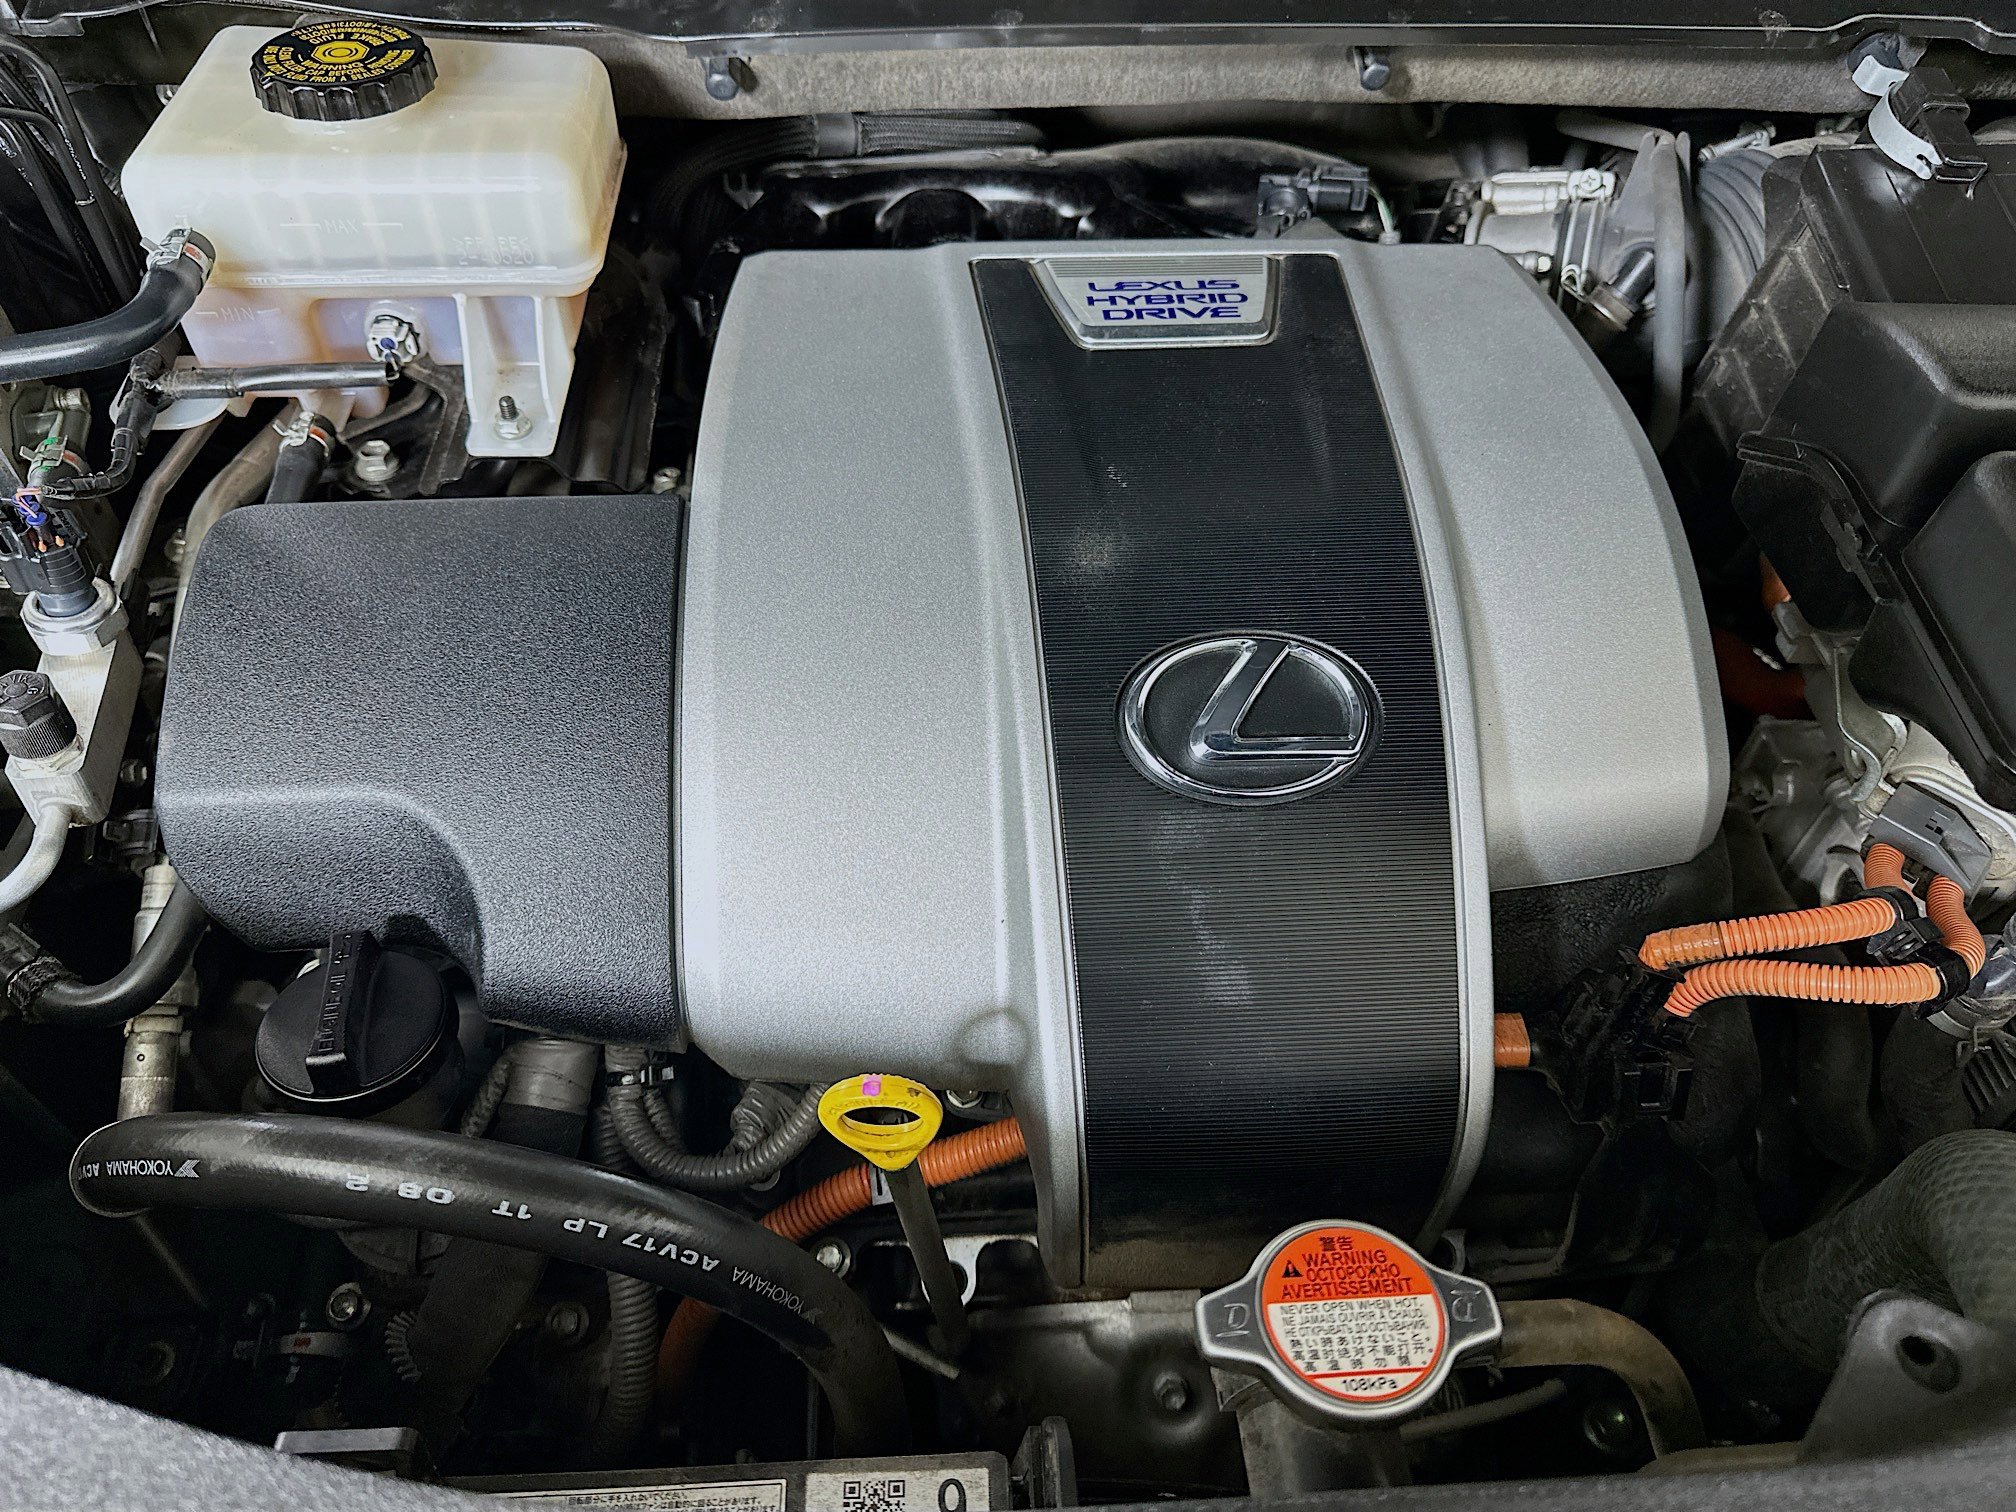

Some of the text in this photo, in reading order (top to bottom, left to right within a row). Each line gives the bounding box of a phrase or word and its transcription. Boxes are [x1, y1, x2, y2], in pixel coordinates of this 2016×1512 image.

[309, 33, 344, 44] FLUID
[350, 33, 385, 46] BRAKE
[301, 60, 364, 71] WARNING
[329, 66, 367, 76] BEFORE
[283, 71, 308, 81] FLUID
[351, 69, 385, 81] SEALED
[324, 220, 358, 234] MAX
[1088, 280, 1240, 292] LEXUS
[1086, 293, 1248, 307] HYBRID
[220, 306, 255, 322] MIN
[1102, 307, 1241, 321] DRIVE
[106, 1160, 173, 1177] YOKOHAMA
[346, 1173, 370, 1192] 2
[397, 1181, 456, 1205] 08
[491, 1200, 533, 1220] 1T
[563, 1218, 609, 1239] LP
[621, 1232, 721, 1272] ACV17
[1319, 1236, 1353, 1252] 警告
[1302, 1249, 1387, 1268] WARNING
[1306, 1263, 1400, 1283] ОСТОРОЖНО
[731, 1267, 805, 1314] YOKOHAMA
[1281, 1277, 1412, 1299] AVERTISSEMENT
[1280, 1303, 1319, 1316] NEVER
[1322, 1301, 1354, 1313] OPEN
[1357, 1299, 1391, 1311] WHEN
[1338, 1309, 1377, 1323] OUVRIR
[1342, 1377, 1397, 1392] 108kPa
